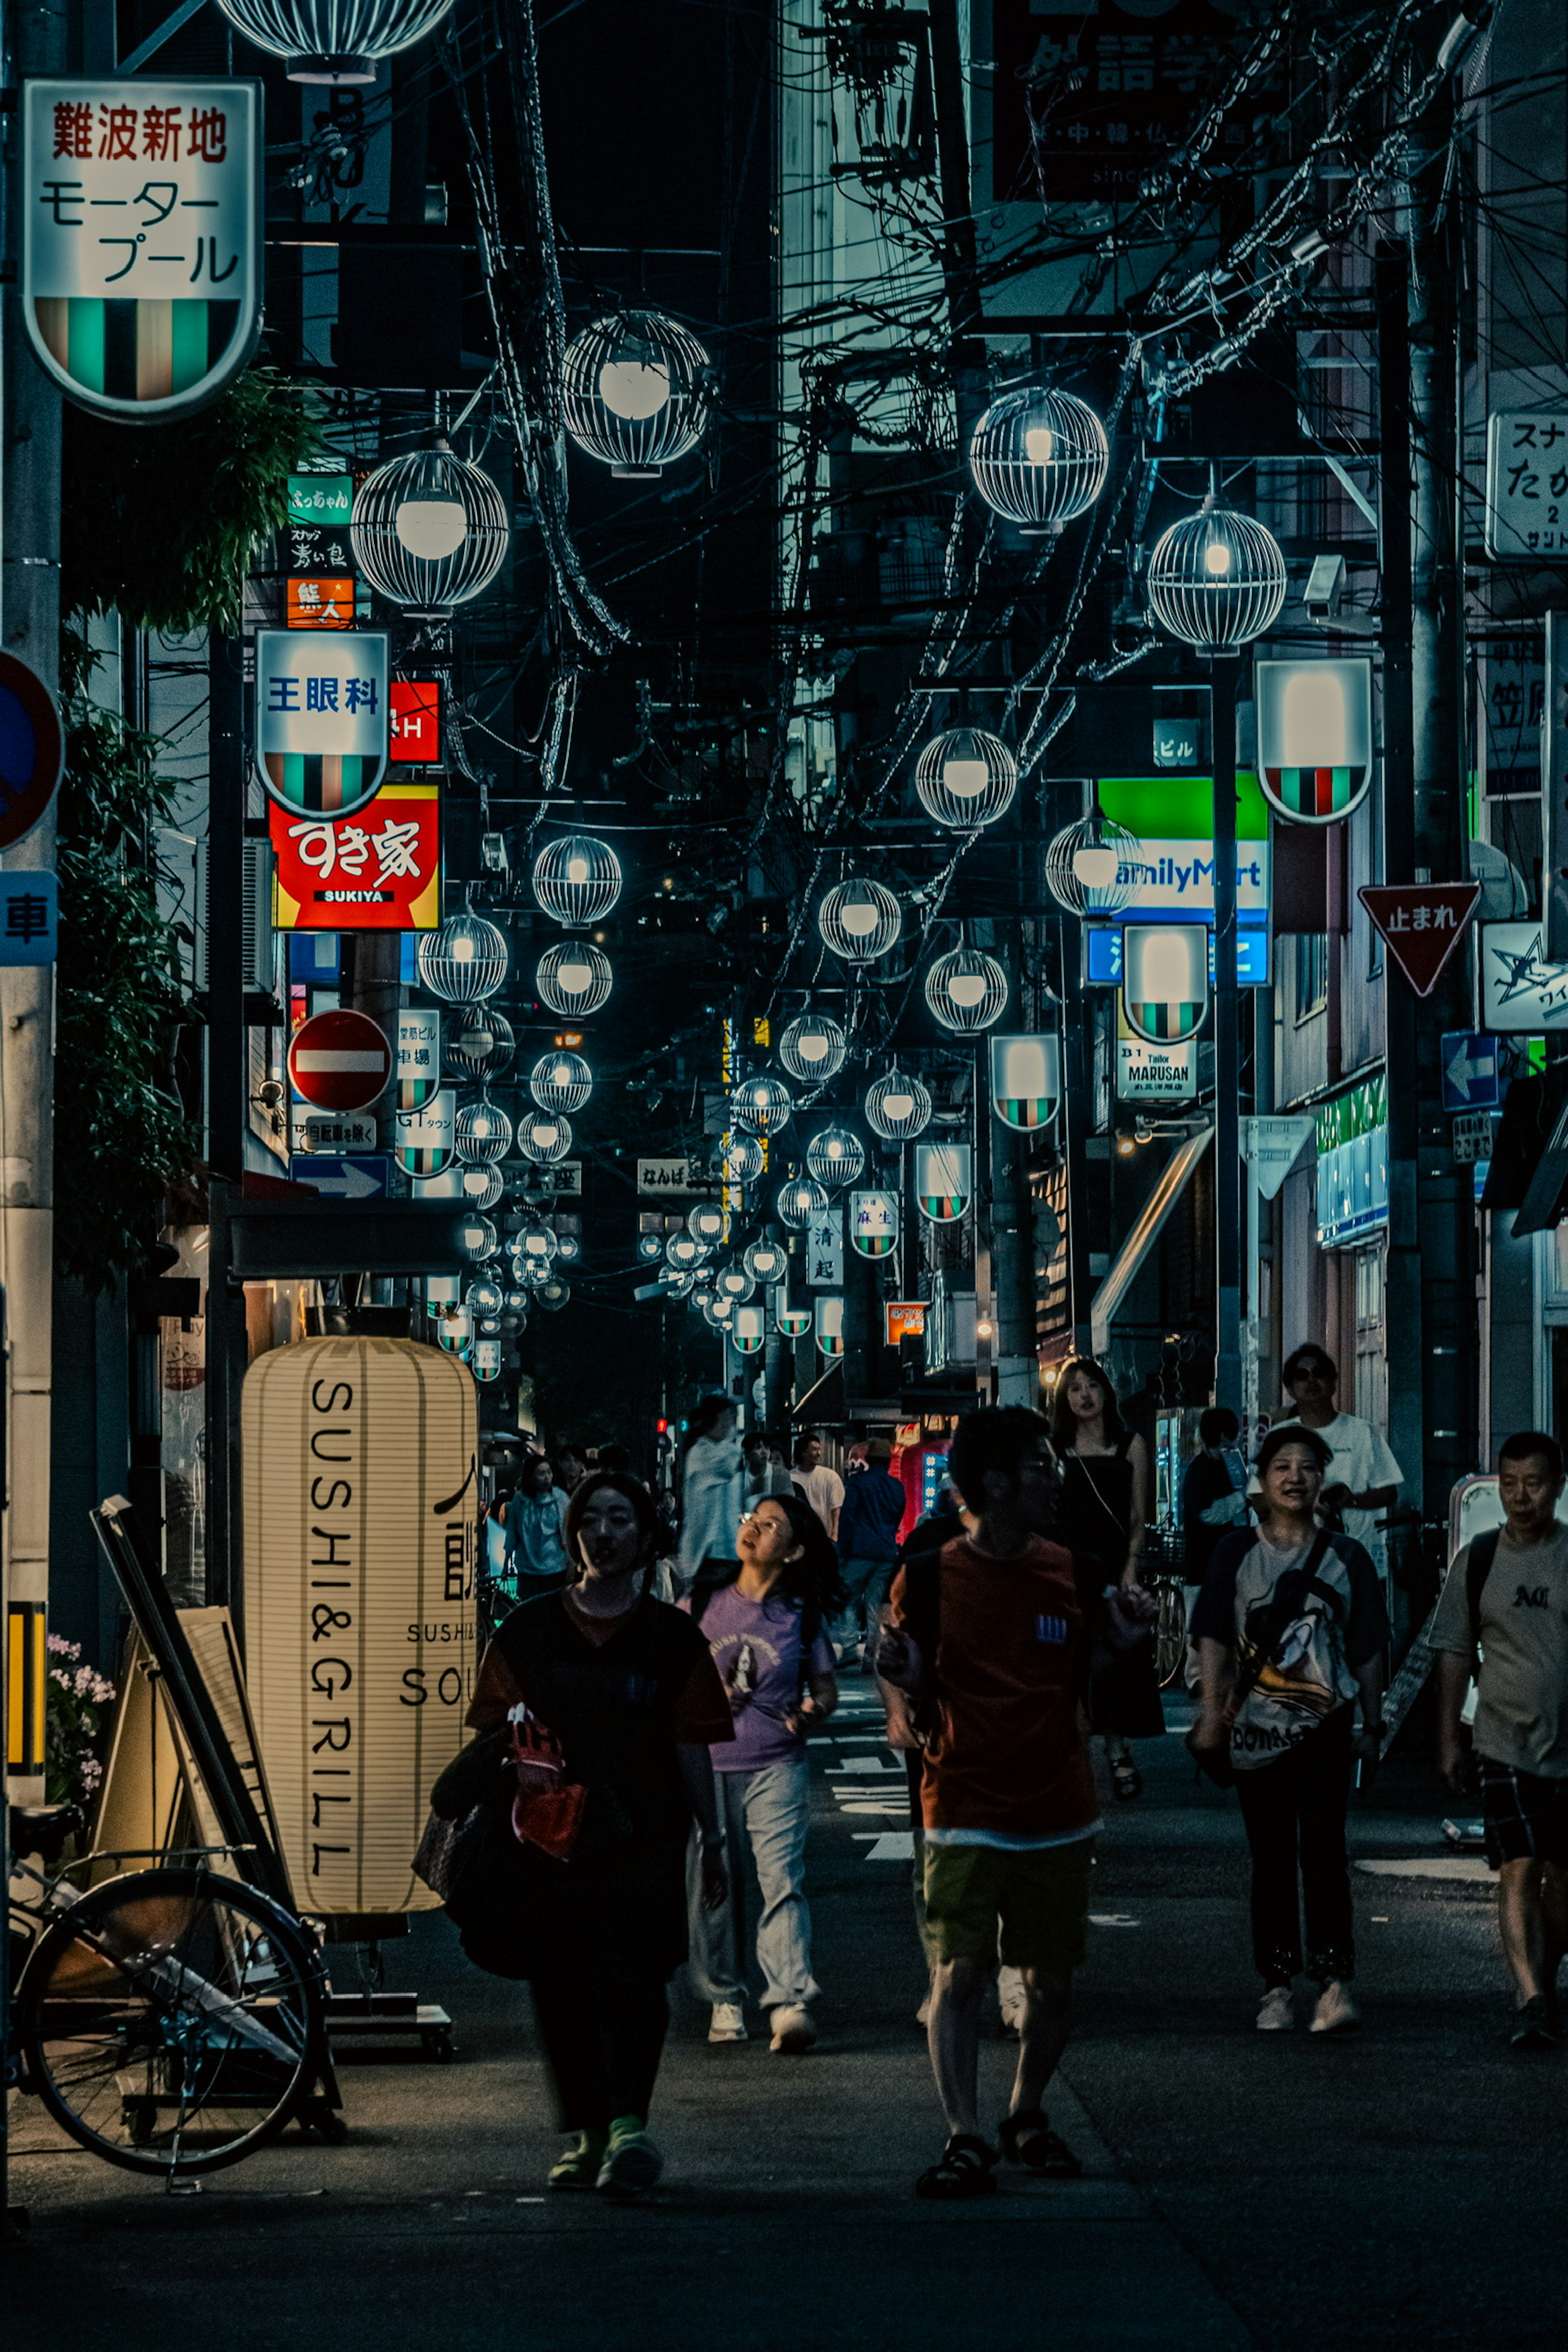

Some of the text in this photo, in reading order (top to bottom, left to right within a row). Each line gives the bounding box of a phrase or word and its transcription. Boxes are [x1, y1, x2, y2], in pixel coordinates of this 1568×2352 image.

[53, 102, 227, 163] 難波新地
[40, 182, 219, 226] モーター
[98, 233, 238, 283] プール
[267, 678, 378, 714] 王眼科
[288, 820, 421, 888] すき家
[325, 890, 383, 902] SUKIYA
[1386, 904, 1457, 933] 止まれ
[1129, 1066, 1188, 1081] MARUSAN
[1148, 1054, 1169, 1064] Tailor
[310, 1124, 372, 1143] 自転車を除く
[311, 1379, 353, 1876] SUSHI&GRILL
